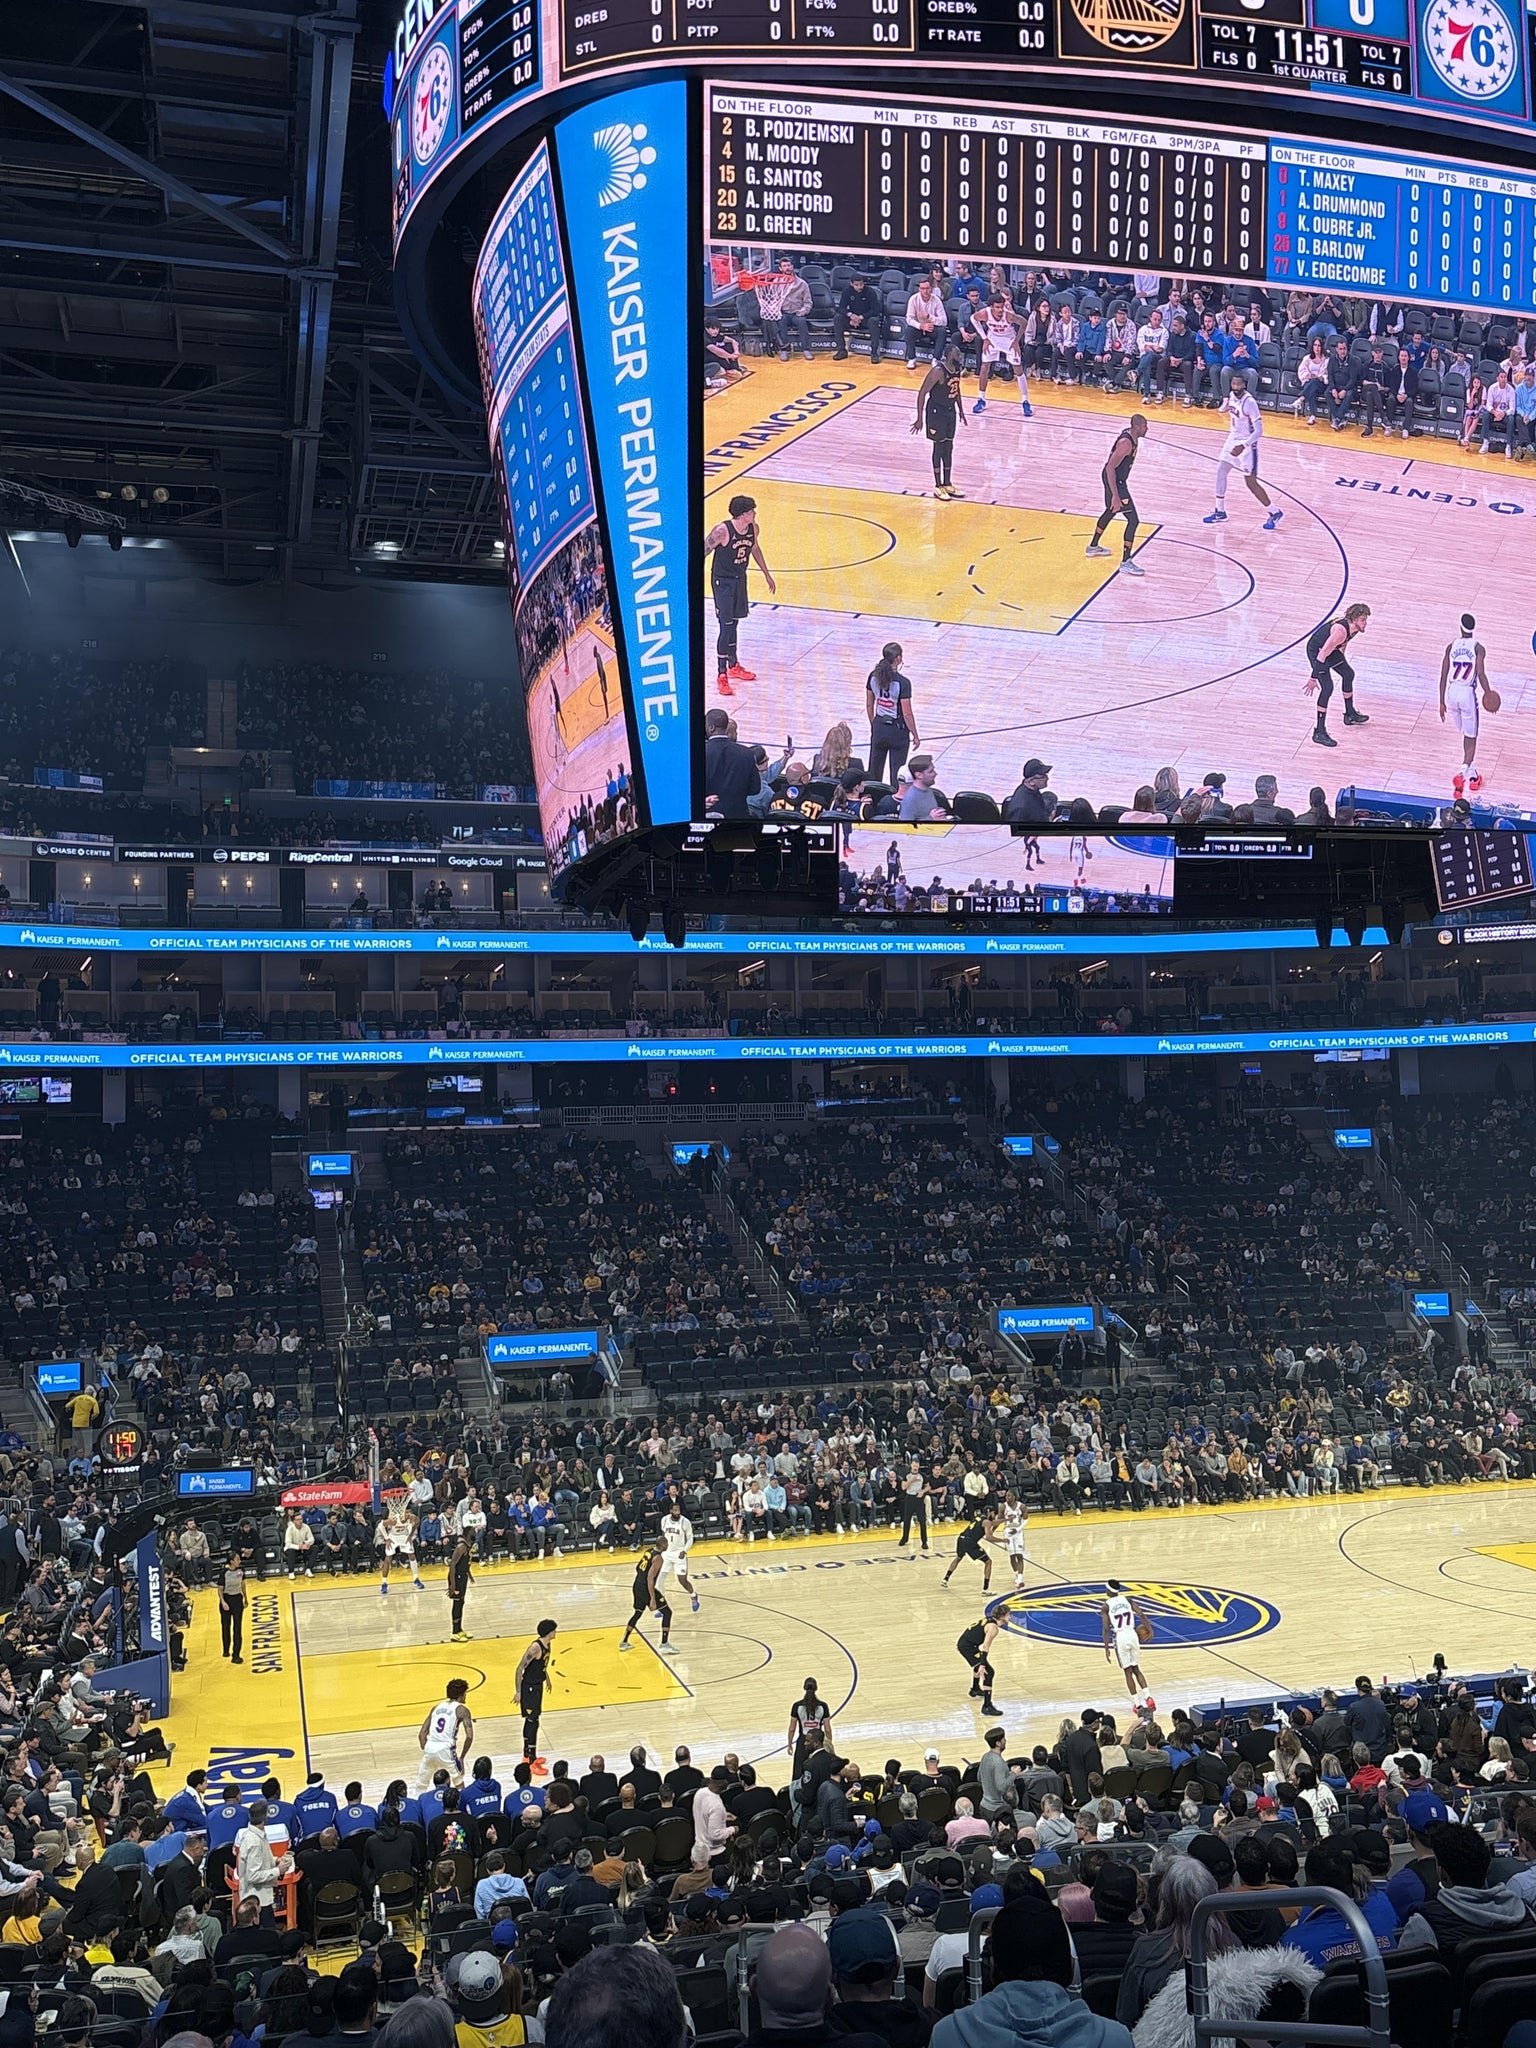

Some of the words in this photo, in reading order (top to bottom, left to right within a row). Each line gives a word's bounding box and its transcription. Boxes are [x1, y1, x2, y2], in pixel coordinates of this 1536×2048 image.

[687, 0, 714, 10] POT
[806, 0, 837, 10] FG%
[928, 1, 977, 14] OREB%
[575, 10, 608, 28] DREB
[463, 17, 484, 42] EFG%
[687, 26, 719, 38] PITP
[806, 26, 835, 38] FT%
[929, 29, 944, 40] FT
[947, 30, 981, 42] RATE
[1212, 24, 1240, 40] TOL
[1247, 26, 1256, 44] 7
[576, 40, 597, 56] STL
[1274, 29, 1345, 68] 11:51
[1448, 16, 1495, 68] 76
[463, 48, 480, 68] TO%
[1213, 51, 1238, 66] FLS
[1246, 52, 1256, 70] 0
[1361, 44, 1386, 61] TOL
[1393, 47, 1402, 65] 7
[464, 66, 490, 94] OREB%
[1272, 63, 1290, 76] 1st
[1292, 66, 1347, 84] QUARTER
[1362, 70, 1386, 86] FLS
[1393, 72, 1402, 90] 0
[464, 107, 474, 121] FT
[474, 89, 493, 116] RATE
[717, 98, 736, 110] ON
[740, 100, 765, 112] THE
[769, 102, 812, 116] FLOOR
[874, 110, 898, 122] MIN
[914, 113, 938, 125] PTS
[953, 116, 978, 128] REB
[992, 120, 1015, 131] AST
[1030, 122, 1052, 134] STL
[1067, 126, 1090, 138] BLK
[1102, 129, 1158, 146] FGM/FGA
[1169, 136, 1220, 152] 3PM/3PA
[1240, 144, 1254, 156] PF
[722, 116, 732, 136] 2
[746, 118, 760, 138] B.
[764, 119, 854, 144] PODZIEMSKI
[722, 140, 732, 160] 4
[746, 142, 764, 162] M.
[766, 144, 820, 166] MOODY
[718, 164, 736, 184] 15
[746, 166, 760, 185] G.
[763, 167, 822, 190] SANTOS
[1275, 150, 1292, 162] ON
[1295, 152, 1316, 164] THE
[1320, 154, 1356, 169] FLOOR
[1405, 166, 1426, 180] MIN
[1438, 172, 1457, 184] PTS
[1468, 176, 1488, 188] REB
[1500, 181, 1518, 194] AST
[1299, 168, 1310, 187] T.
[1313, 170, 1356, 192] MAXEY
[717, 188, 738, 207] 20
[746, 190, 760, 208] A.
[764, 191, 833, 214] HORFORD
[1280, 189, 1286, 207] 1
[1298, 191, 1310, 210] A.
[1313, 192, 1386, 219] DRUMMOND
[718, 212, 737, 230] 23
[746, 214, 760, 232] D.
[764, 214, 812, 236] GREEN
[1298, 214, 1310, 232] K.
[1313, 216, 1354, 238] OUBRE
[1356, 222, 1376, 240] JR.
[1274, 234, 1290, 252] 25
[1298, 236, 1310, 254] D.
[1312, 238, 1365, 262] BARLOW
[1274, 256, 1290, 276] 77
[1297, 260, 1309, 278] V.
[1312, 261, 1386, 286] EDGECOMBE
[602, 222, 648, 387] KAISER
[706, 381, 857, 459] FRANCISCO
[1334, 476, 1478, 508] CENTER
[737, 548, 746, 558] 15
[1452, 661, 1473, 681] 77
[50, 846, 78, 855] CHASE
[124, 850, 158, 858] FOUNDING
[160, 851, 194, 859] PARTNERS
[231, 851, 270, 862] PEPSI
[288, 852, 354, 864] RingCentral
[448, 856, 478, 868] Google
[480, 858, 502, 866] Cloud
[997, 896, 1020, 908] 11:51
[36, 936, 64, 945] KAISER
[66, 936, 122, 948] PERMANENTE
[150, 938, 202, 948] OFFICIAL
[206, 938, 238, 948] TEAM
[240, 939, 308, 949] PHYSICIANS
[310, 939, 326, 948] OF
[328, 939, 350, 948] THE
[354, 939, 412, 948] WARRIORS
[452, 940, 477, 949] KAISER
[479, 940, 530, 950] PERMANENTE
[748, 941, 792, 950] OFFICIAL
[794, 942, 820, 950] TEAM
[822, 942, 879, 951] PHYSICIANS
[881, 942, 894, 951] OF
[895, 942, 914, 951] THE
[916, 942, 966, 951] WARRIORS
[1268, 1038, 1316, 1049] OFFICIAL
[1318, 1038, 1346, 1047] TEAM
[1348, 1035, 1408, 1046] PHYSICIANS
[1410, 1034, 1425, 1044] OF
[1428, 1034, 1449, 1043] THE
[1452, 1031, 1509, 1042] WARRIORS
[12, 1054, 42, 1064] KAISER
[44, 1054, 102, 1064] PERMANENTE
[130, 1053, 186, 1064] OFFICIAL
[188, 1053, 222, 1063] TEAM
[225, 1052, 294, 1062] PHYSICIANS
[297, 1052, 314, 1062] OF
[316, 1052, 338, 1061] THE
[342, 1051, 402, 1061] WARRIORS
[1018, 1320, 1040, 1328] KAISER
[1042, 1318, 1089, 1326] PERMANENTE
[510, 1346, 536, 1355] KAISER
[538, 1343, 592, 1354] PERMANENTE
[109, 1431, 137, 1444] 11:50
[116, 1444, 132, 1459] 17
[113, 1465, 140, 1474] TISSOT
[691, 1564, 808, 1580] CENTER
[148, 1565, 162, 1642] ADVANTEST
[252, 1594, 282, 1650] FRANCISCO
[1114, 1612, 1131, 1628] 77
[252, 1652, 283, 1674] SAN
[436, 1717, 446, 1733] 9
[303, 1801, 330, 1812] 76ERS
[475, 1794, 498, 1806] 76ERS
